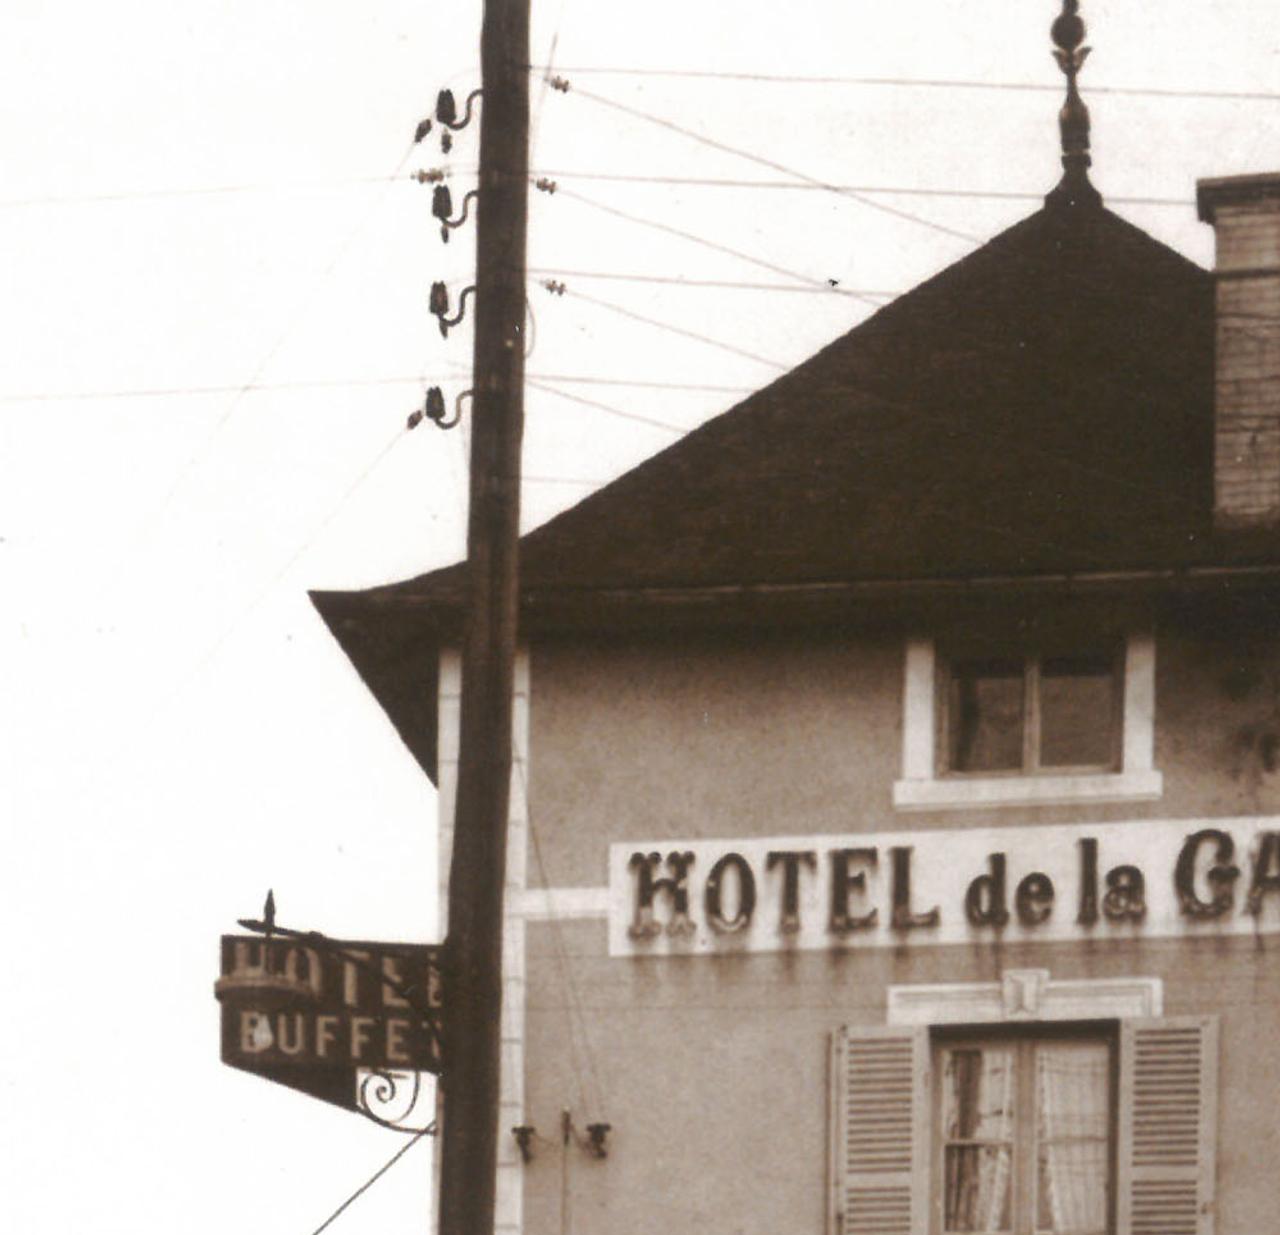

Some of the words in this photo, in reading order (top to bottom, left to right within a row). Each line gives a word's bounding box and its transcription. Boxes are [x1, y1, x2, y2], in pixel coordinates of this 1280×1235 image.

[627, 846, 941, 940] HOTEL
[965, 851, 1055, 929] de
[1076, 836, 1148, 926] la
